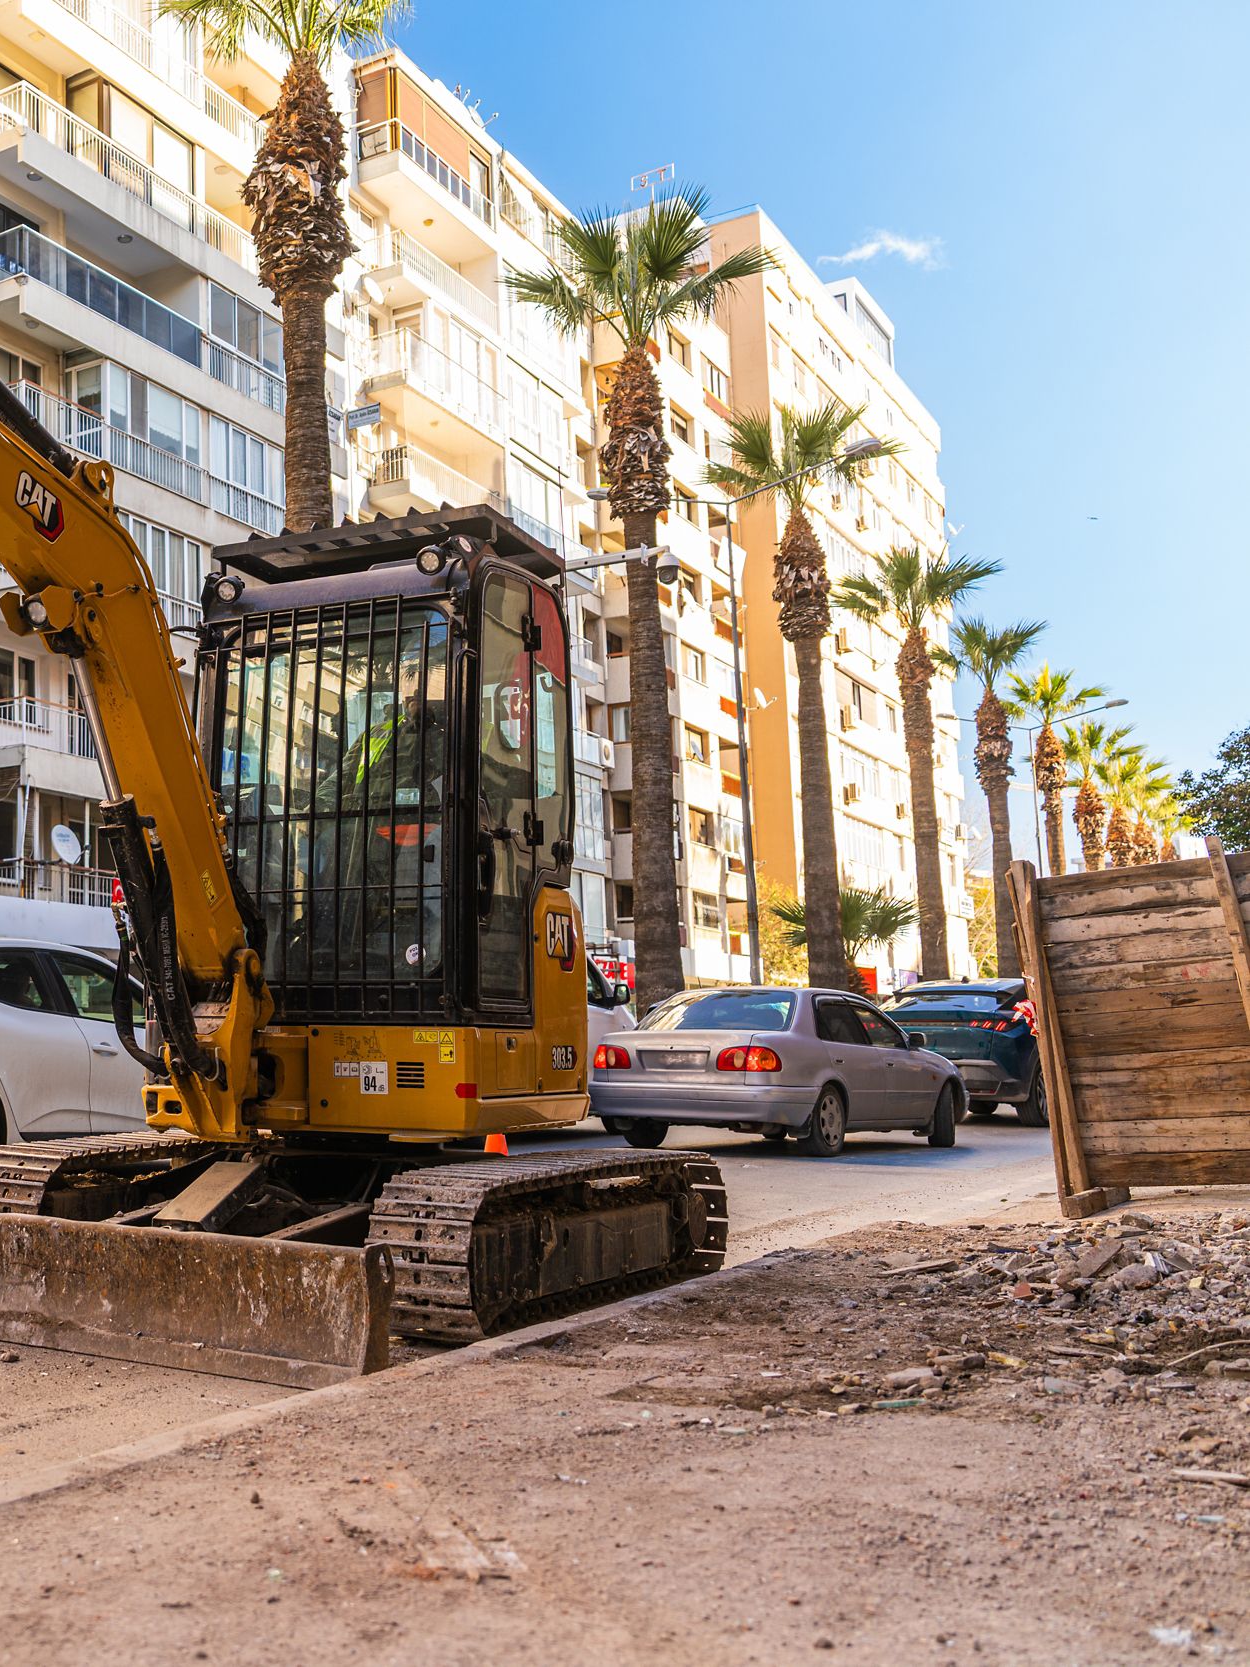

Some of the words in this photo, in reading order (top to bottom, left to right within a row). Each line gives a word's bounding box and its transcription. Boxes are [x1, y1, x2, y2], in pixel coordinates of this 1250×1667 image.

[16, 471, 57, 527] CAT
[546, 912, 570, 958] CAT
[165, 981, 176, 1001] CAT
[552, 1046, 573, 1070] 303.5
[364, 1075, 377, 1092] 94
